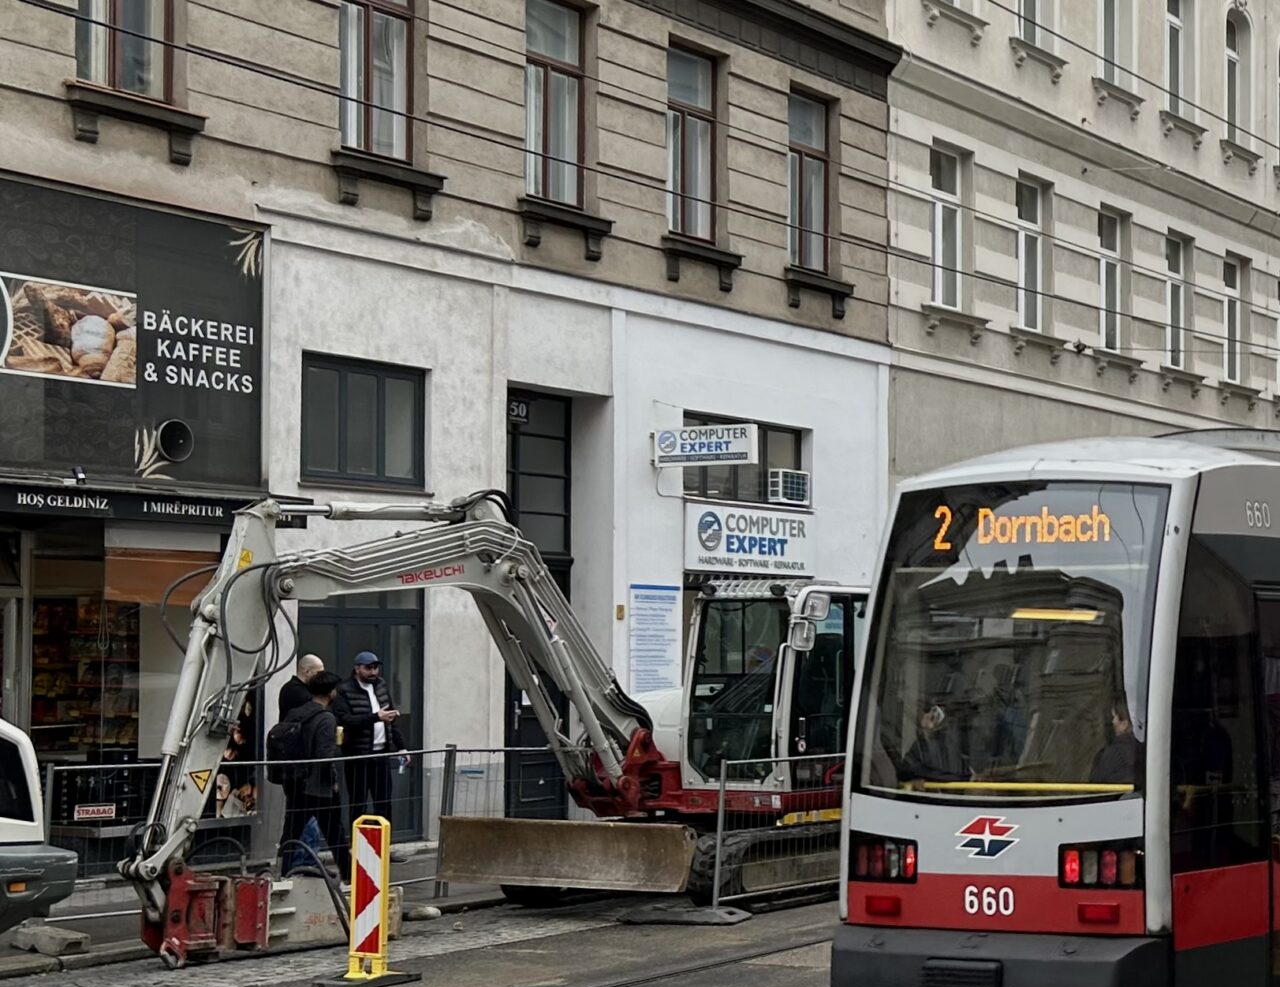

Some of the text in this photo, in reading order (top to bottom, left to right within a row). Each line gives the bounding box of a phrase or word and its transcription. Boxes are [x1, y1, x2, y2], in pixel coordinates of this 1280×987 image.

[144, 309, 254, 345] BÄCKEREI
[157, 339, 241, 367] KAFFEE
[144, 362, 253, 393] & SNACKS
[509, 402, 527, 417] 50
[680, 427, 748, 441] COMPUTER
[680, 441, 732, 453] EXPERT
[17, 492, 109, 510] HOŞ GELDİNİZ
[150, 501, 223, 517] MIRËPRITUR
[725, 513, 806, 538] COMPUTER
[1246, 501, 1271, 527] 660
[933, 505, 1111, 550] 2 Dornbach
[726, 535, 788, 557] EXPERT
[699, 556, 806, 570] HARDWARE SOFTWARE REPARATUR
[964, 885, 1015, 916] 660
